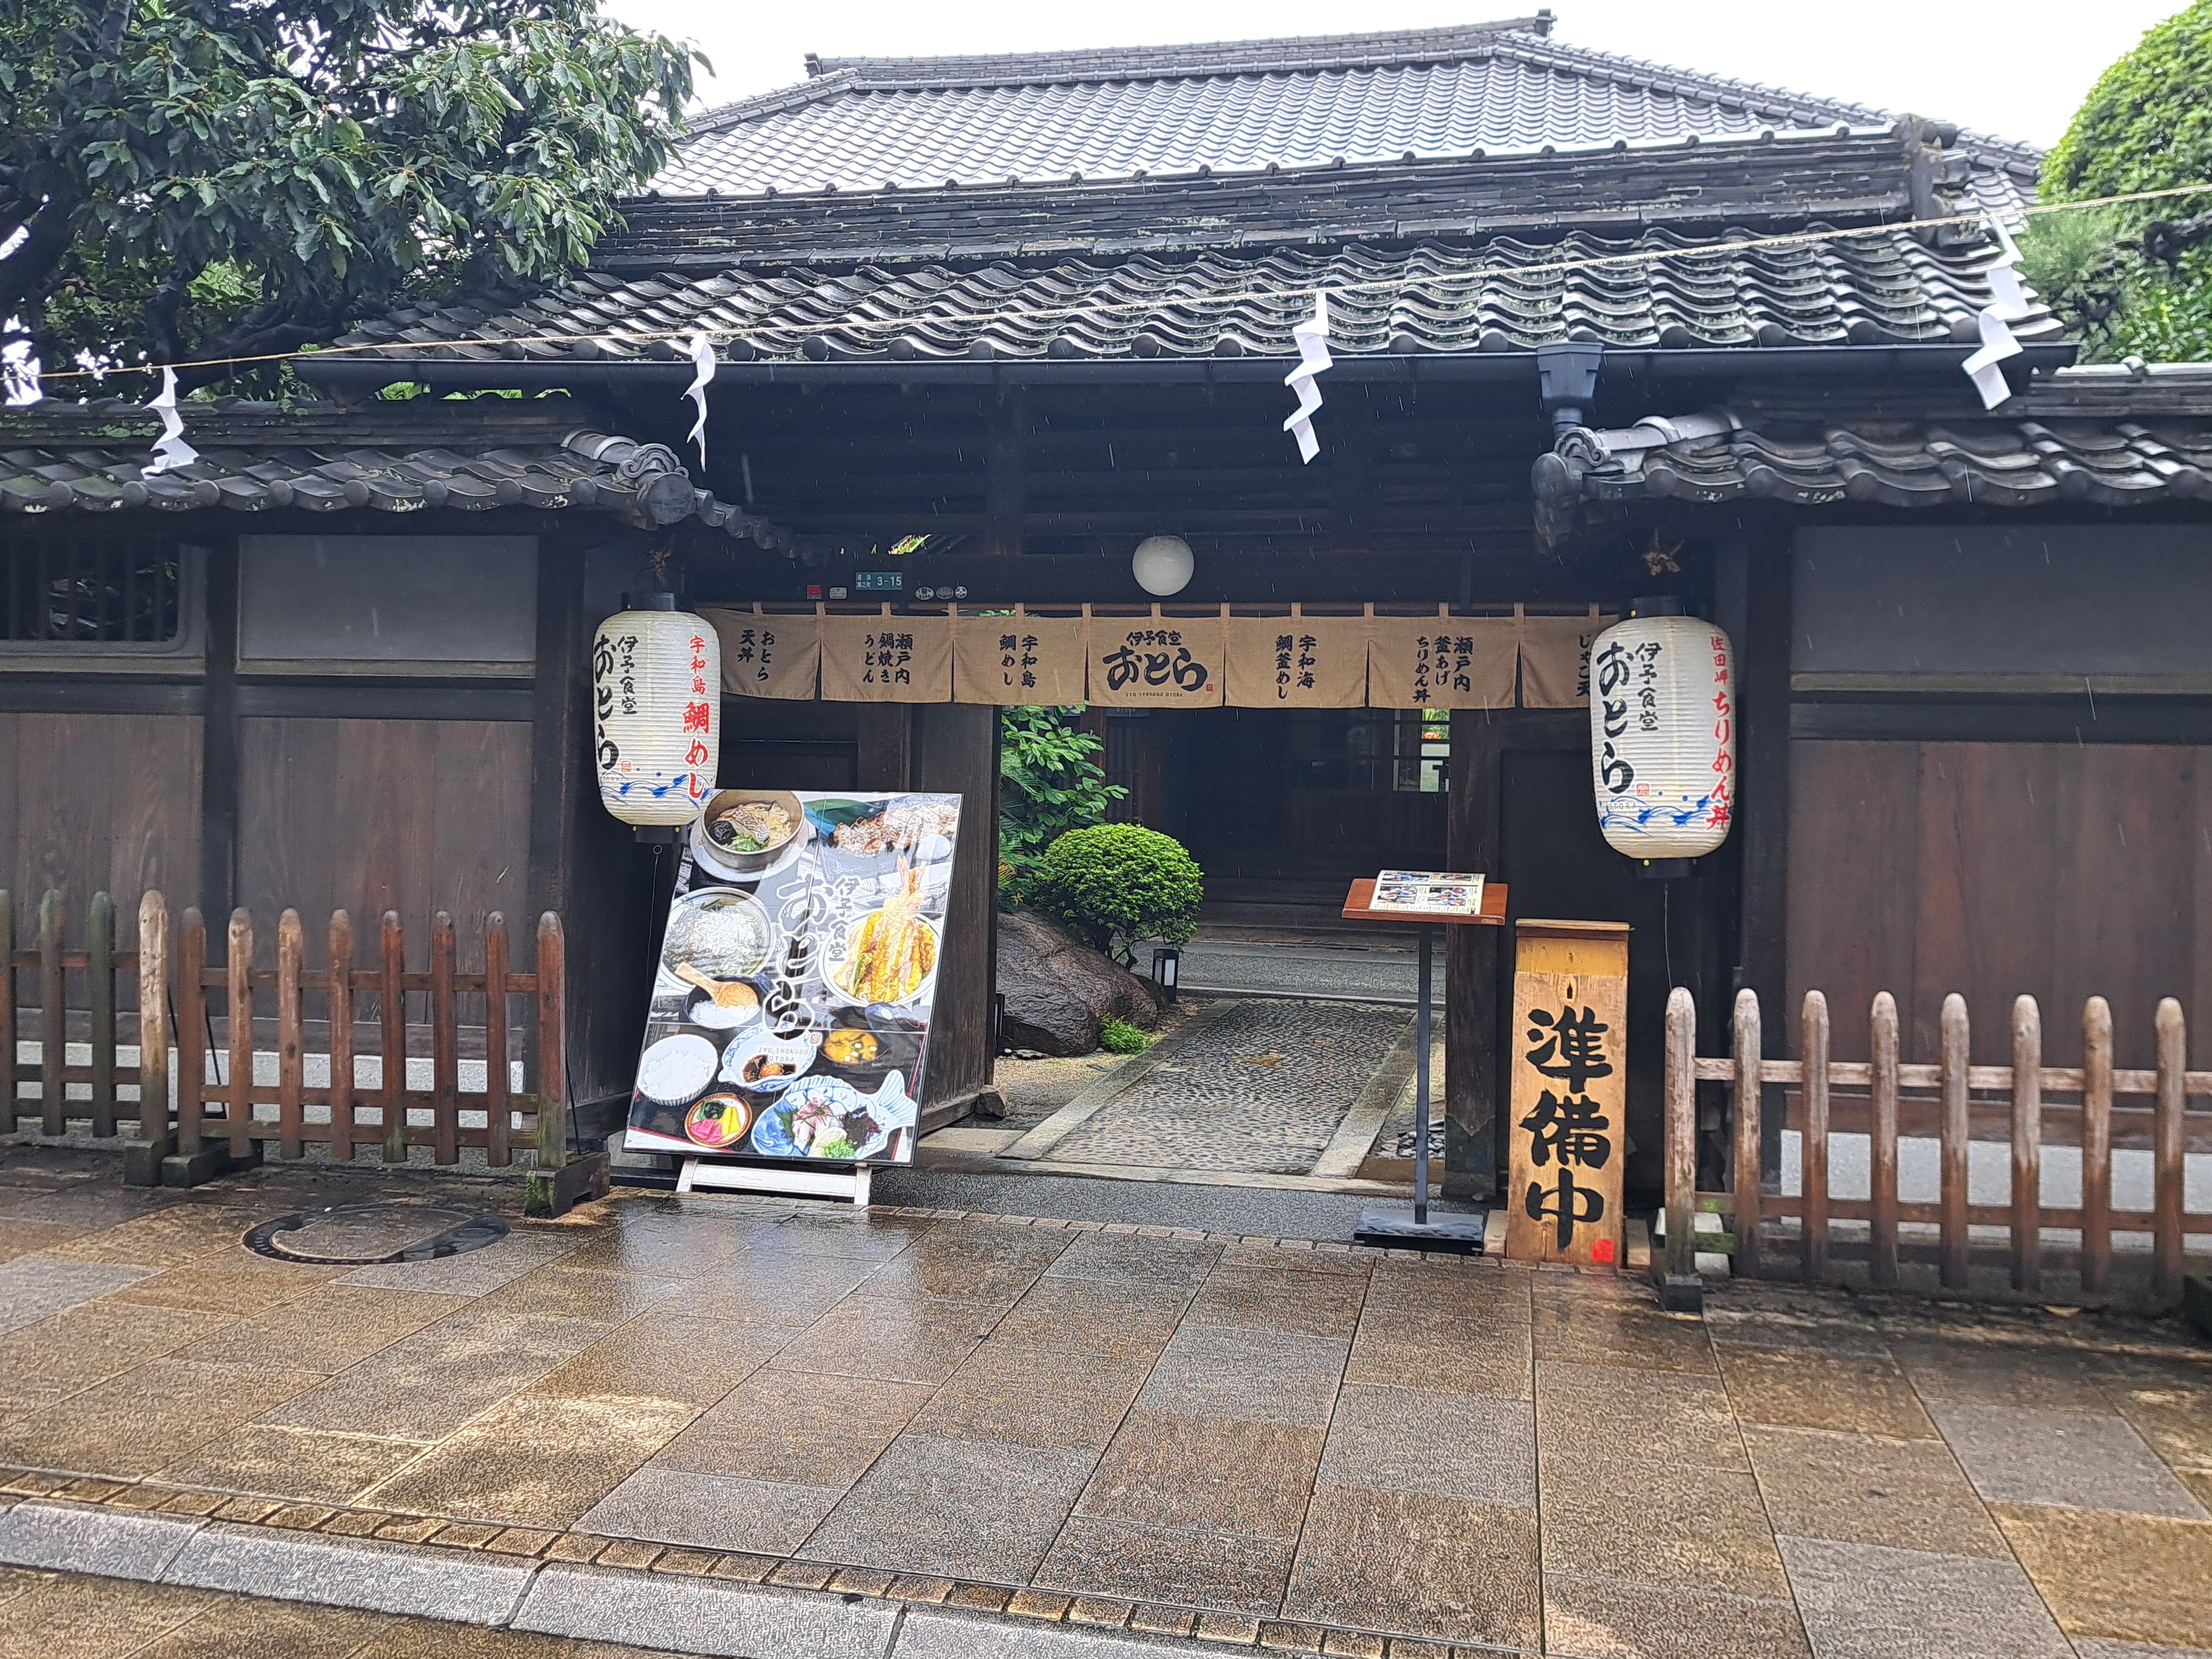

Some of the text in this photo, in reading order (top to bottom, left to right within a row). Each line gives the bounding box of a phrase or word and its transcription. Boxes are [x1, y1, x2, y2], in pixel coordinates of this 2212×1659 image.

[877, 576, 902, 587] 3-15
[737, 629, 755, 664] 天丼
[758, 630, 775, 681] おとら
[863, 634, 874, 683] うどん
[877, 632, 895, 683] 鍋焼き
[895, 633, 913, 685] 瀬戸内
[999, 634, 1016, 686] 鯛めし
[1021, 634, 1039, 688] 宇和島
[1126, 630, 1182, 646] 伊予食堂
[1297, 634, 1317, 689] 宇和海
[1434, 635, 1452, 686] 釜あげ
[1453, 636, 1473, 692] 瀬戸内
[618, 636, 638, 715] 伊予食堂
[1102, 645, 1207, 691] おとら
[1275, 635, 1293, 699] 鯛釜めし
[1412, 636, 1431, 703] ちりめん丼
[1635, 642, 1662, 731] 伊予食堂
[594, 634, 619, 770] おとら
[683, 635, 710, 798] 宇和島 鯛めし
[1597, 641, 1634, 794] おとら
[1706, 637, 1732, 830] 佐田岬 ちりめん丼
[829, 877, 860, 962] 伊予食堂
[765, 874, 834, 1040] おとら
[1519, 1005, 1613, 1253] 準備中
